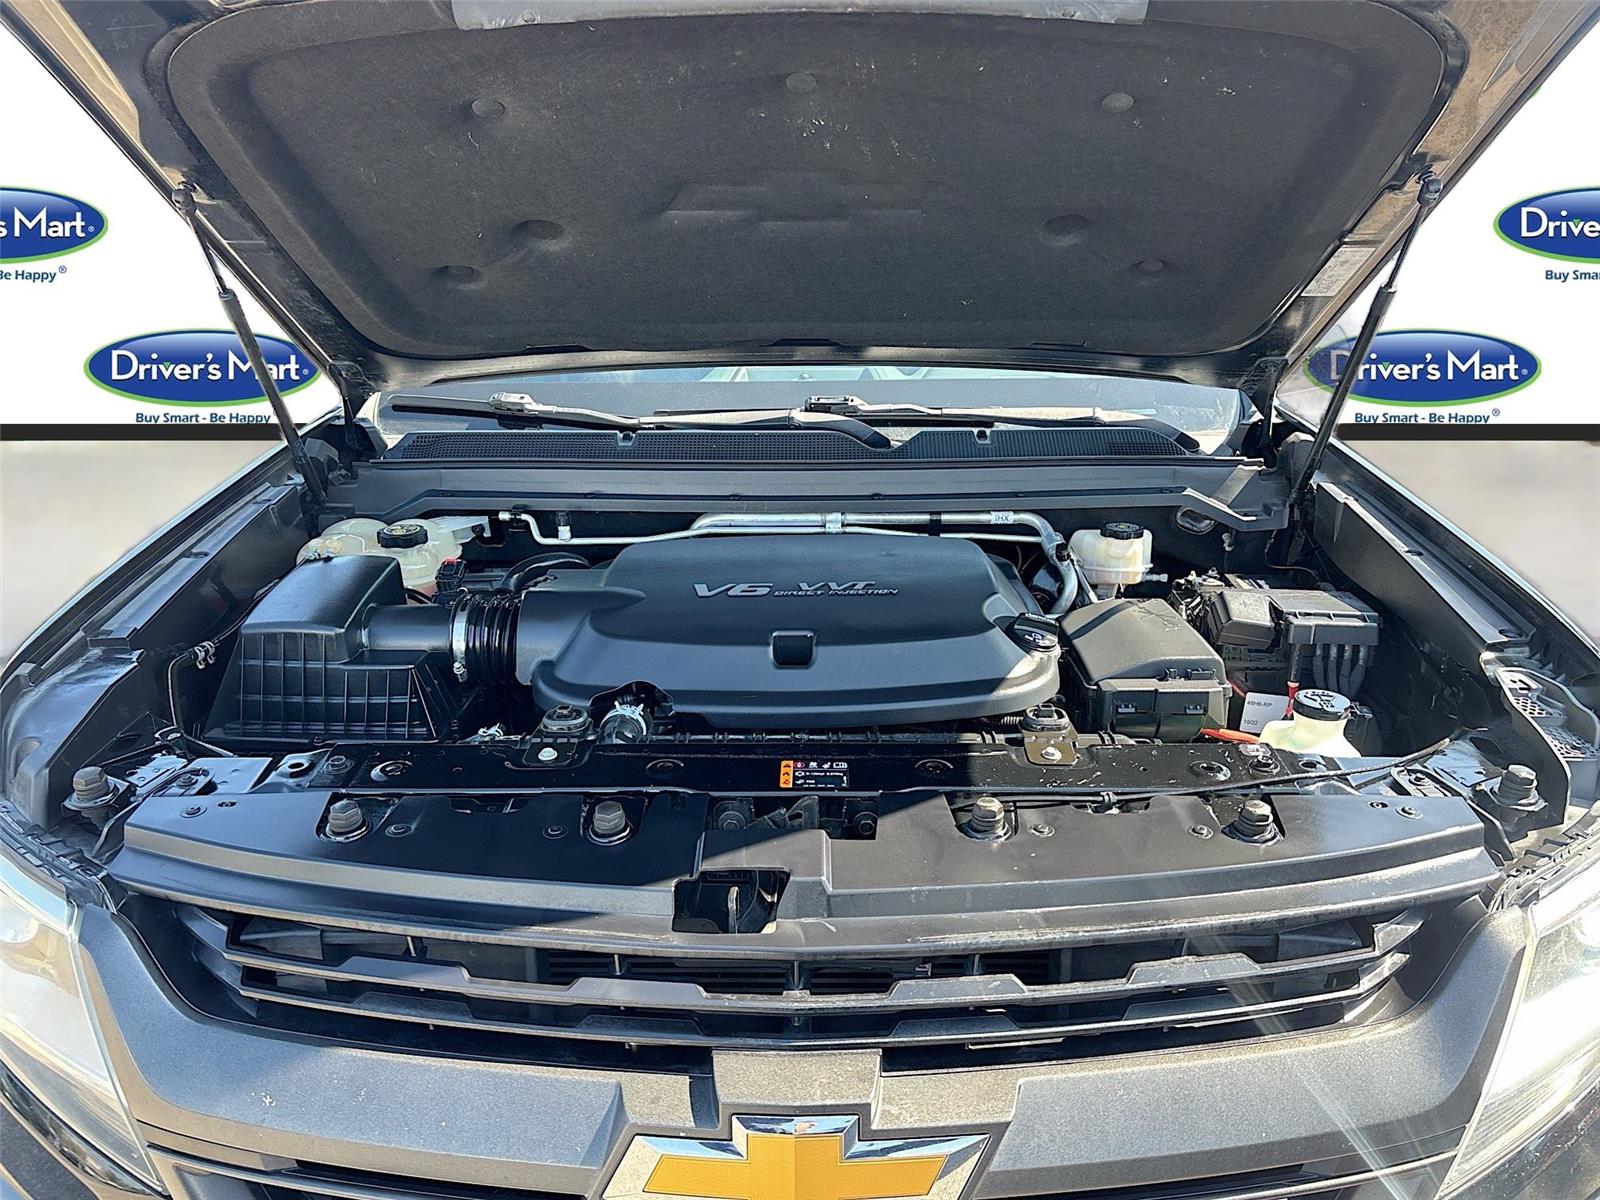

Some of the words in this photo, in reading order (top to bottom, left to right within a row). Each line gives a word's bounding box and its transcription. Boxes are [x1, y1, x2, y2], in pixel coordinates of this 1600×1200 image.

[14, 206, 86, 238] Mart
[15, 270, 57, 283] Happy
[1545, 269, 1570, 283] Buy
[1572, 269, 1600, 280] Sma
[111, 349, 222, 381] Driver's
[1447, 349, 1520, 381] Mart
[135, 412, 160, 424] Buy
[163, 412, 200, 423] Smart
[210, 412, 226, 423] Be
[229, 412, 271, 424] Happy
[1354, 412, 1379, 424] Buy
[1382, 412, 1419, 423] Smart
[1429, 412, 1445, 423] Be
[1448, 412, 1490, 424] Happy
[693, 582, 774, 598] V6
[774, 589, 826, 597] DIRECT
[828, 588, 900, 597] INJECTION
[798, 581, 876, 591] VVT
